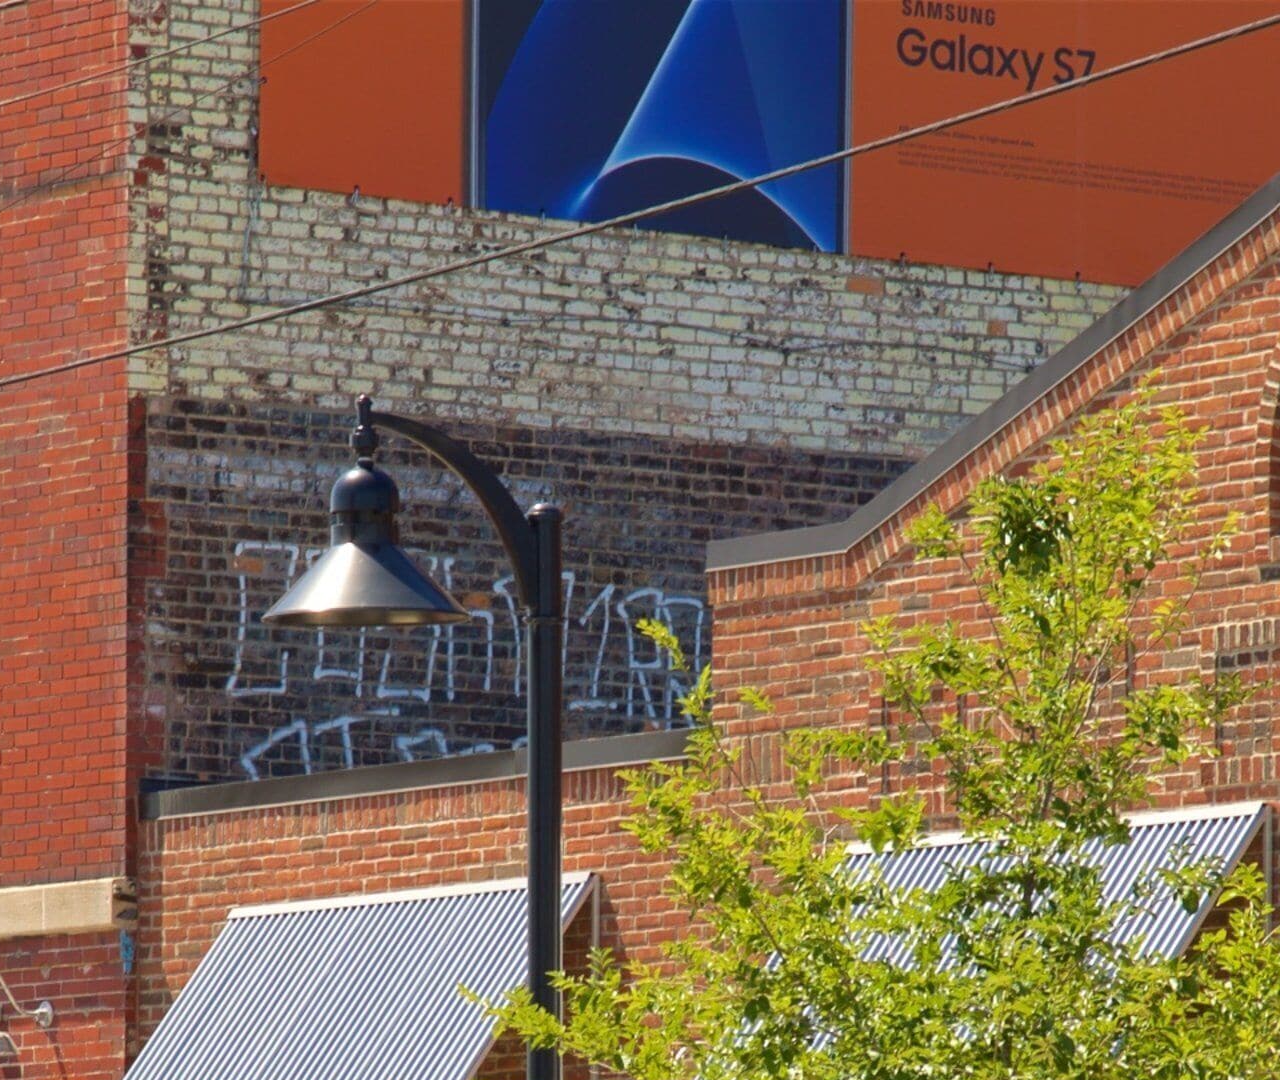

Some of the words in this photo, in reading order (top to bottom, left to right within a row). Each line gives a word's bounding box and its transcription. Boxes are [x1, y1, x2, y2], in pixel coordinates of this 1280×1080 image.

[902, 0, 996, 26] SAMSUNG
[897, 27, 1045, 92] Galaxy
[1052, 47, 1096, 85] S7
